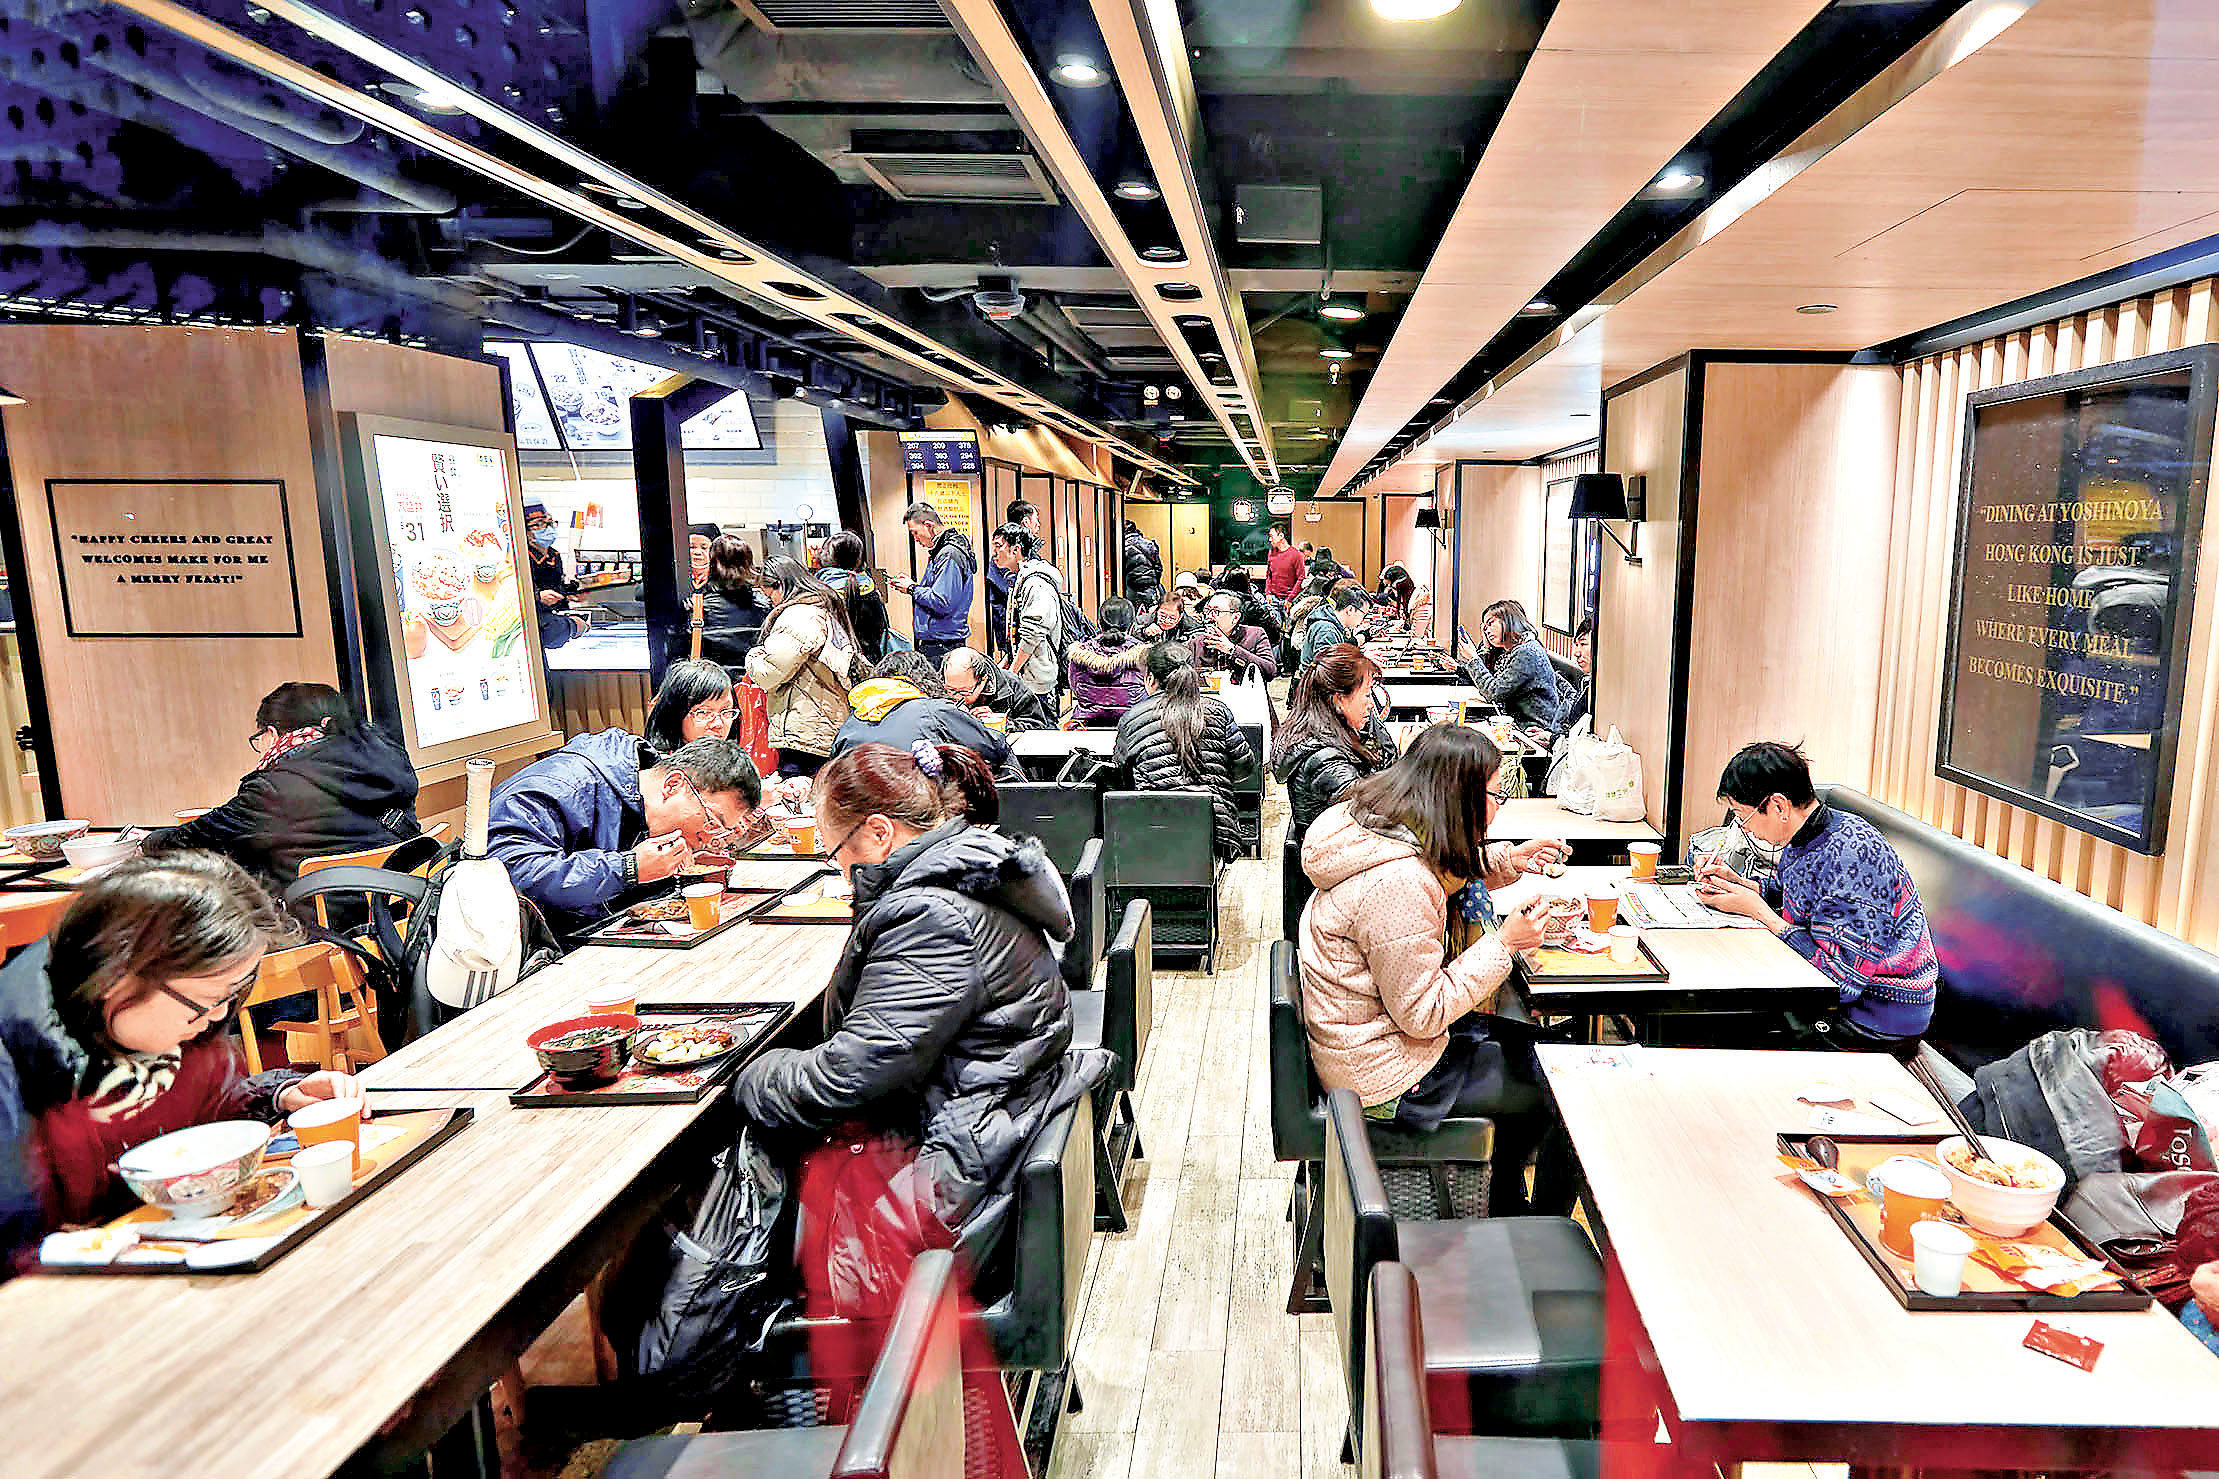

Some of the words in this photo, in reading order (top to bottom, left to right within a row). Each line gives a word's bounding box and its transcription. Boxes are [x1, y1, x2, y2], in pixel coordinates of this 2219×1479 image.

[431, 453, 455, 533] 賢い選択
[2039, 502, 2057, 522] AT
[2060, 499, 2164, 523] YOSHINOYA
[129, 535, 187, 544] CHEERS
[191, 535, 221, 544] AND
[225, 535, 273, 544] GREAT
[81, 555, 162, 564] WELCOMES
[167, 555, 209, 564] MAKE
[213, 555, 242, 564] FOR
[247, 555, 269, 564] ME
[1985, 543, 2025, 563] HONG
[2027, 543, 2073, 565] KONG
[2077, 545, 2094, 566] IS
[116, 574, 127, 583] A
[130, 574, 180, 583] MERRY
[2008, 583, 2041, 604] LIKE
[1975, 618, 2025, 643] WHERE
[2028, 625, 2081, 651] EVERY
[2084, 633, 2133, 659] MEAL
[1968, 656, 2033, 684] BECOMES
[2171, 1127, 2193, 1171] TOS
